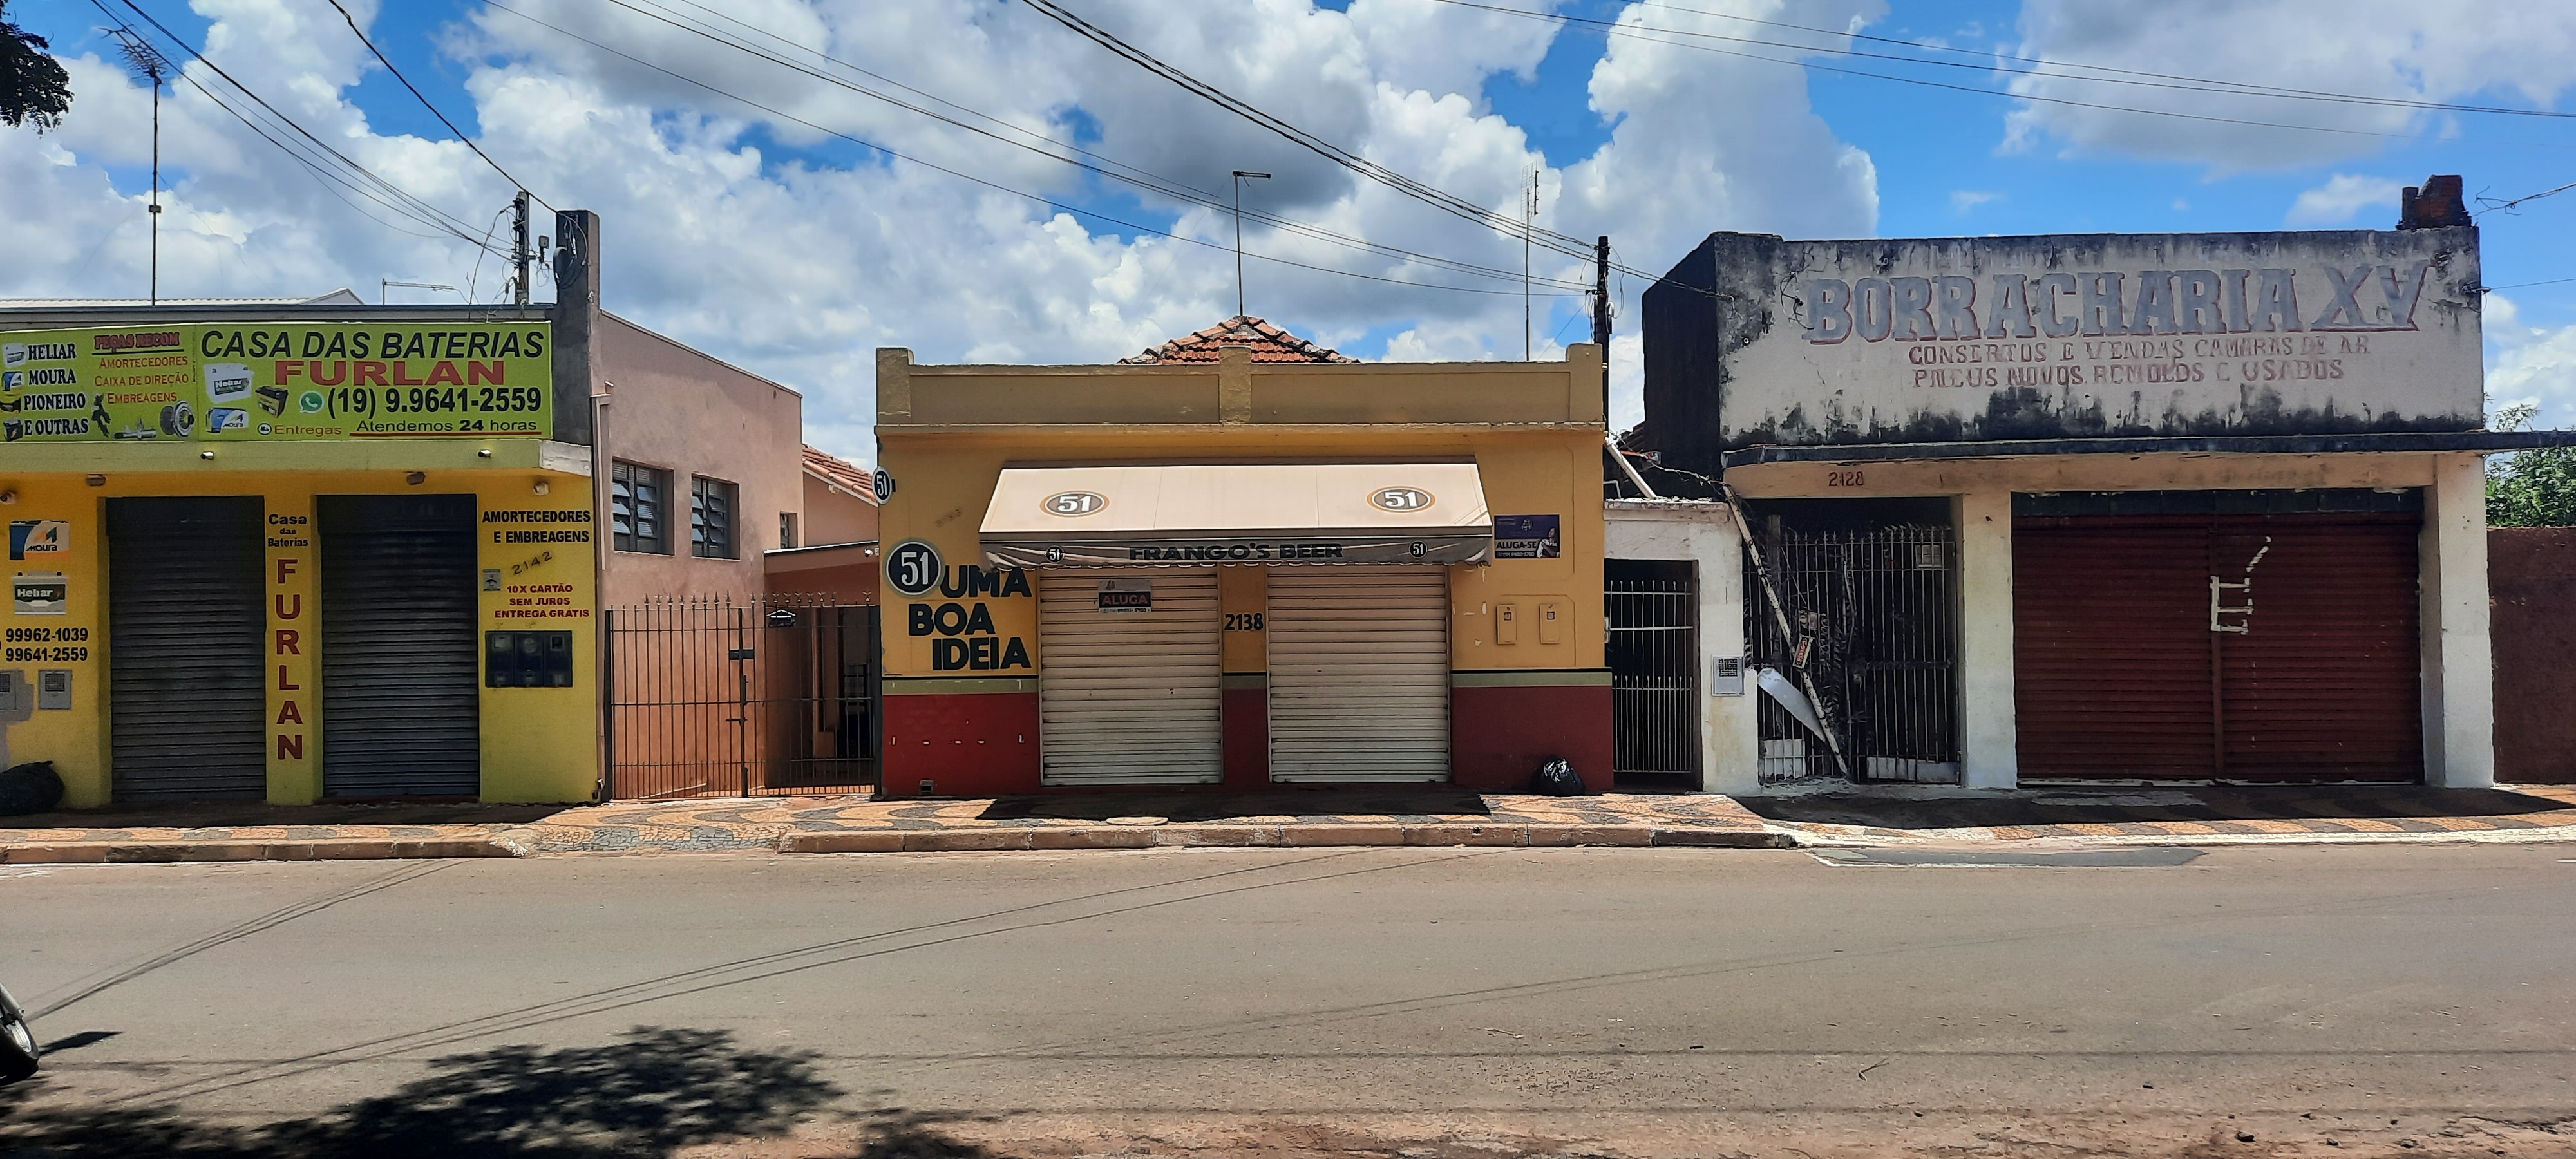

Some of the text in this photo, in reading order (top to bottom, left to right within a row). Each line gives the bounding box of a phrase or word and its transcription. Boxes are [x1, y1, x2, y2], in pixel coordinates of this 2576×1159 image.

[1803, 258, 2438, 345] BORRACHARIA XV
[28, 343, 76, 360] HELIAR
[94, 334, 134, 353] PEÇAS
[202, 331, 544, 359] CASA DAS BATERIAS
[1909, 343, 2047, 365] CONSERTOS
[2084, 339, 2184, 359] VENDAS
[99, 356, 188, 369] AMORTECEDORES
[29, 368, 76, 385] MOURA
[95, 372, 189, 387] CAIXA DE DIREÇÃO
[275, 360, 504, 386] FURLAN
[24, 393, 86, 410] PIONEIRO
[108, 392, 177, 404] EMBREAGENS
[327, 388, 542, 419] (19) 9.9641-2559
[24, 419, 88, 435] E OUTRAS
[274, 425, 342, 437] Entregas
[356, 419, 536, 432] Atendemos 24 horas
[876, 475, 888, 496] 51
[1828, 471, 1864, 487] 2128
[1057, 495, 1092, 513] 51
[1384, 491, 1417, 507] 51
[268, 513, 307, 525] Casa
[482, 510, 591, 523] AMORTECEDORES
[268, 537, 308, 547] Baterias
[493, 531, 589, 543] E EMBREAGENS
[1496, 541, 1537, 549] ALUGA-SE
[1048, 548, 1061, 560] 51
[1129, 542, 1343, 561] FRANGO'S BEER
[1412, 543, 1425, 556] 51
[512, 551, 553, 575] 2142
[901, 552, 929, 586] 51
[530, 583, 573, 593] CARTÃO
[940, 565, 1032, 598] UMA
[1102, 594, 1148, 605] ALUGA
[495, 608, 590, 618] ENTREGA GRÁTIS
[909, 602, 996, 636] BOA
[1224, 613, 1264, 631] 2138
[6, 627, 88, 642] 99962-1039
[6, 647, 88, 662] 99641-2559
[276, 559, 303, 760] FURLAN
[932, 636, 1032, 670] IDEIA
